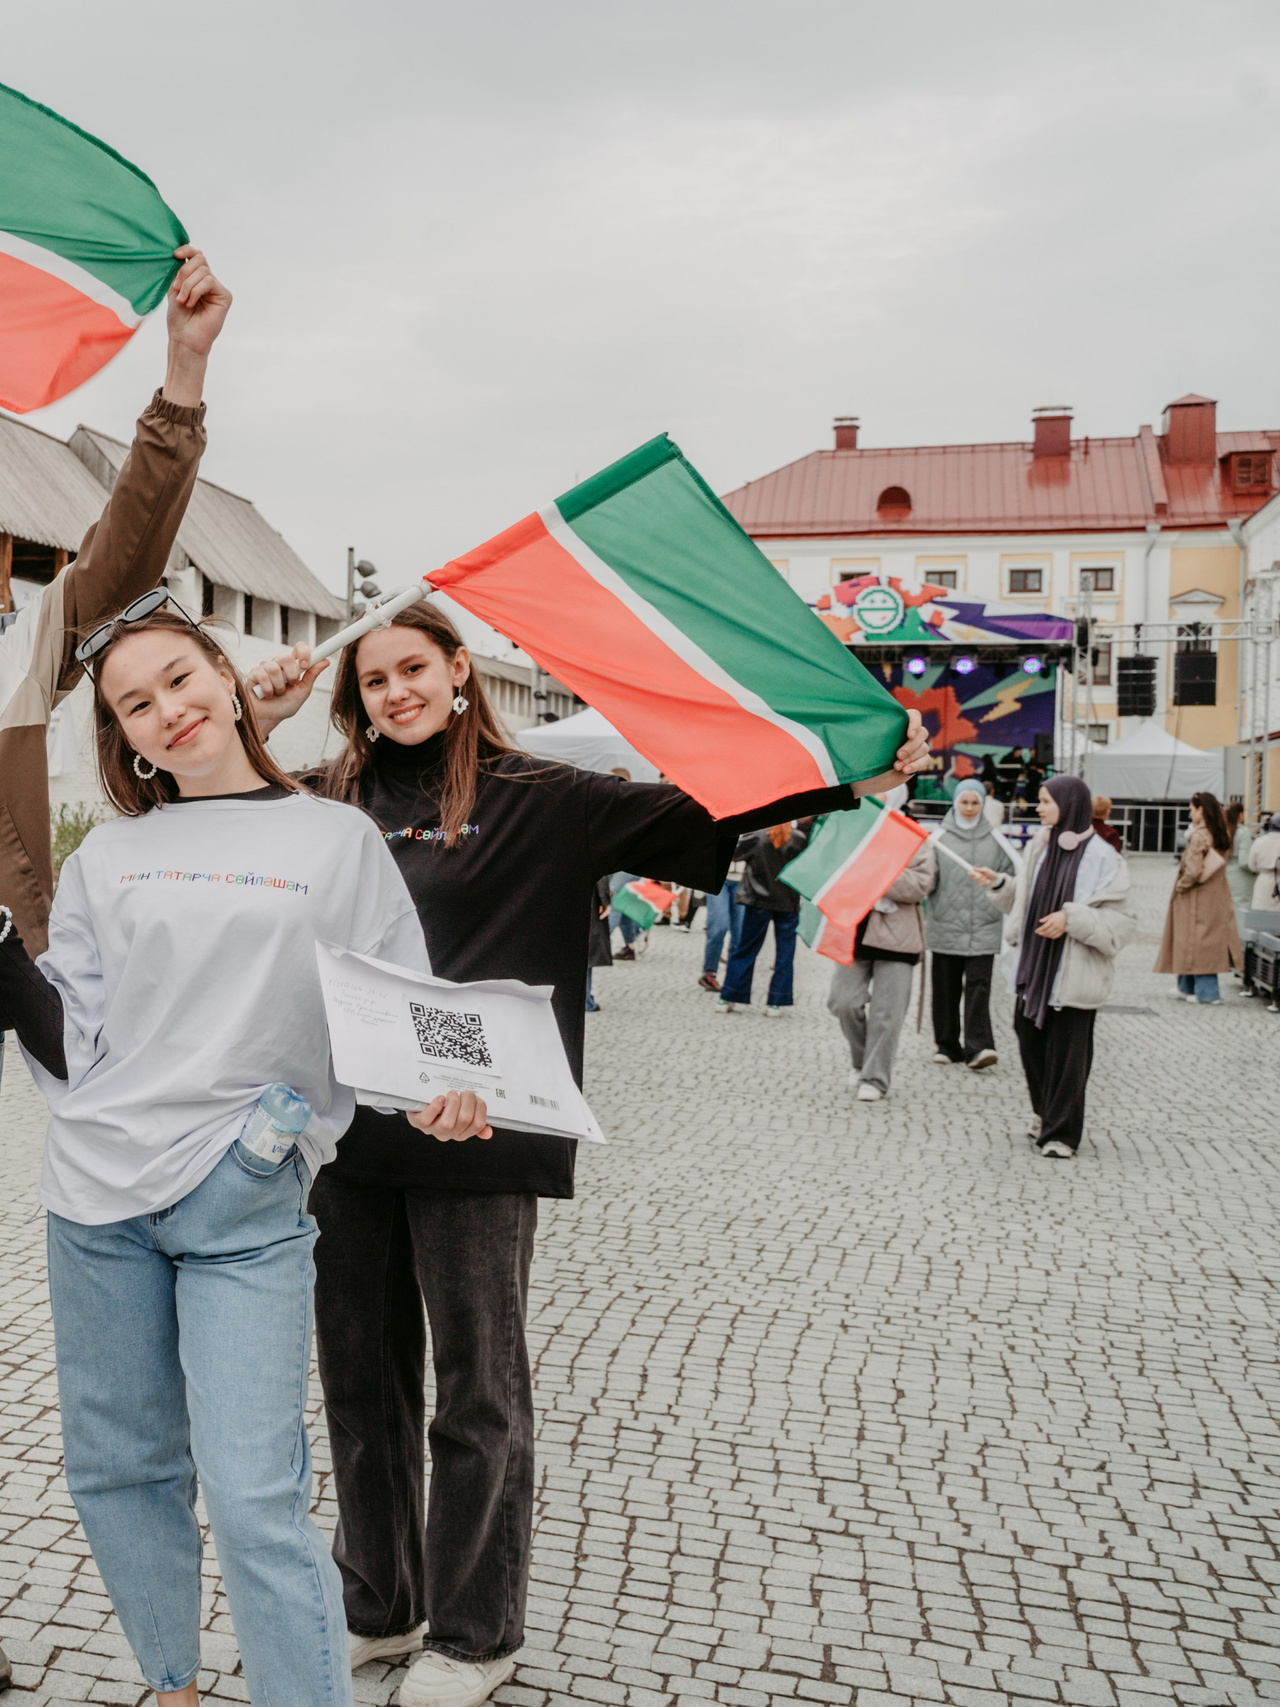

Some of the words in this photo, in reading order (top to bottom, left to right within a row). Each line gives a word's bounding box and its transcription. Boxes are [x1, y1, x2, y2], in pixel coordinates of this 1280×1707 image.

[120, 872, 151, 884] МИН
[156, 870, 221, 883] ТАТАРЧА
[225, 872, 309, 895] СӨЙЛӘШӘМ
